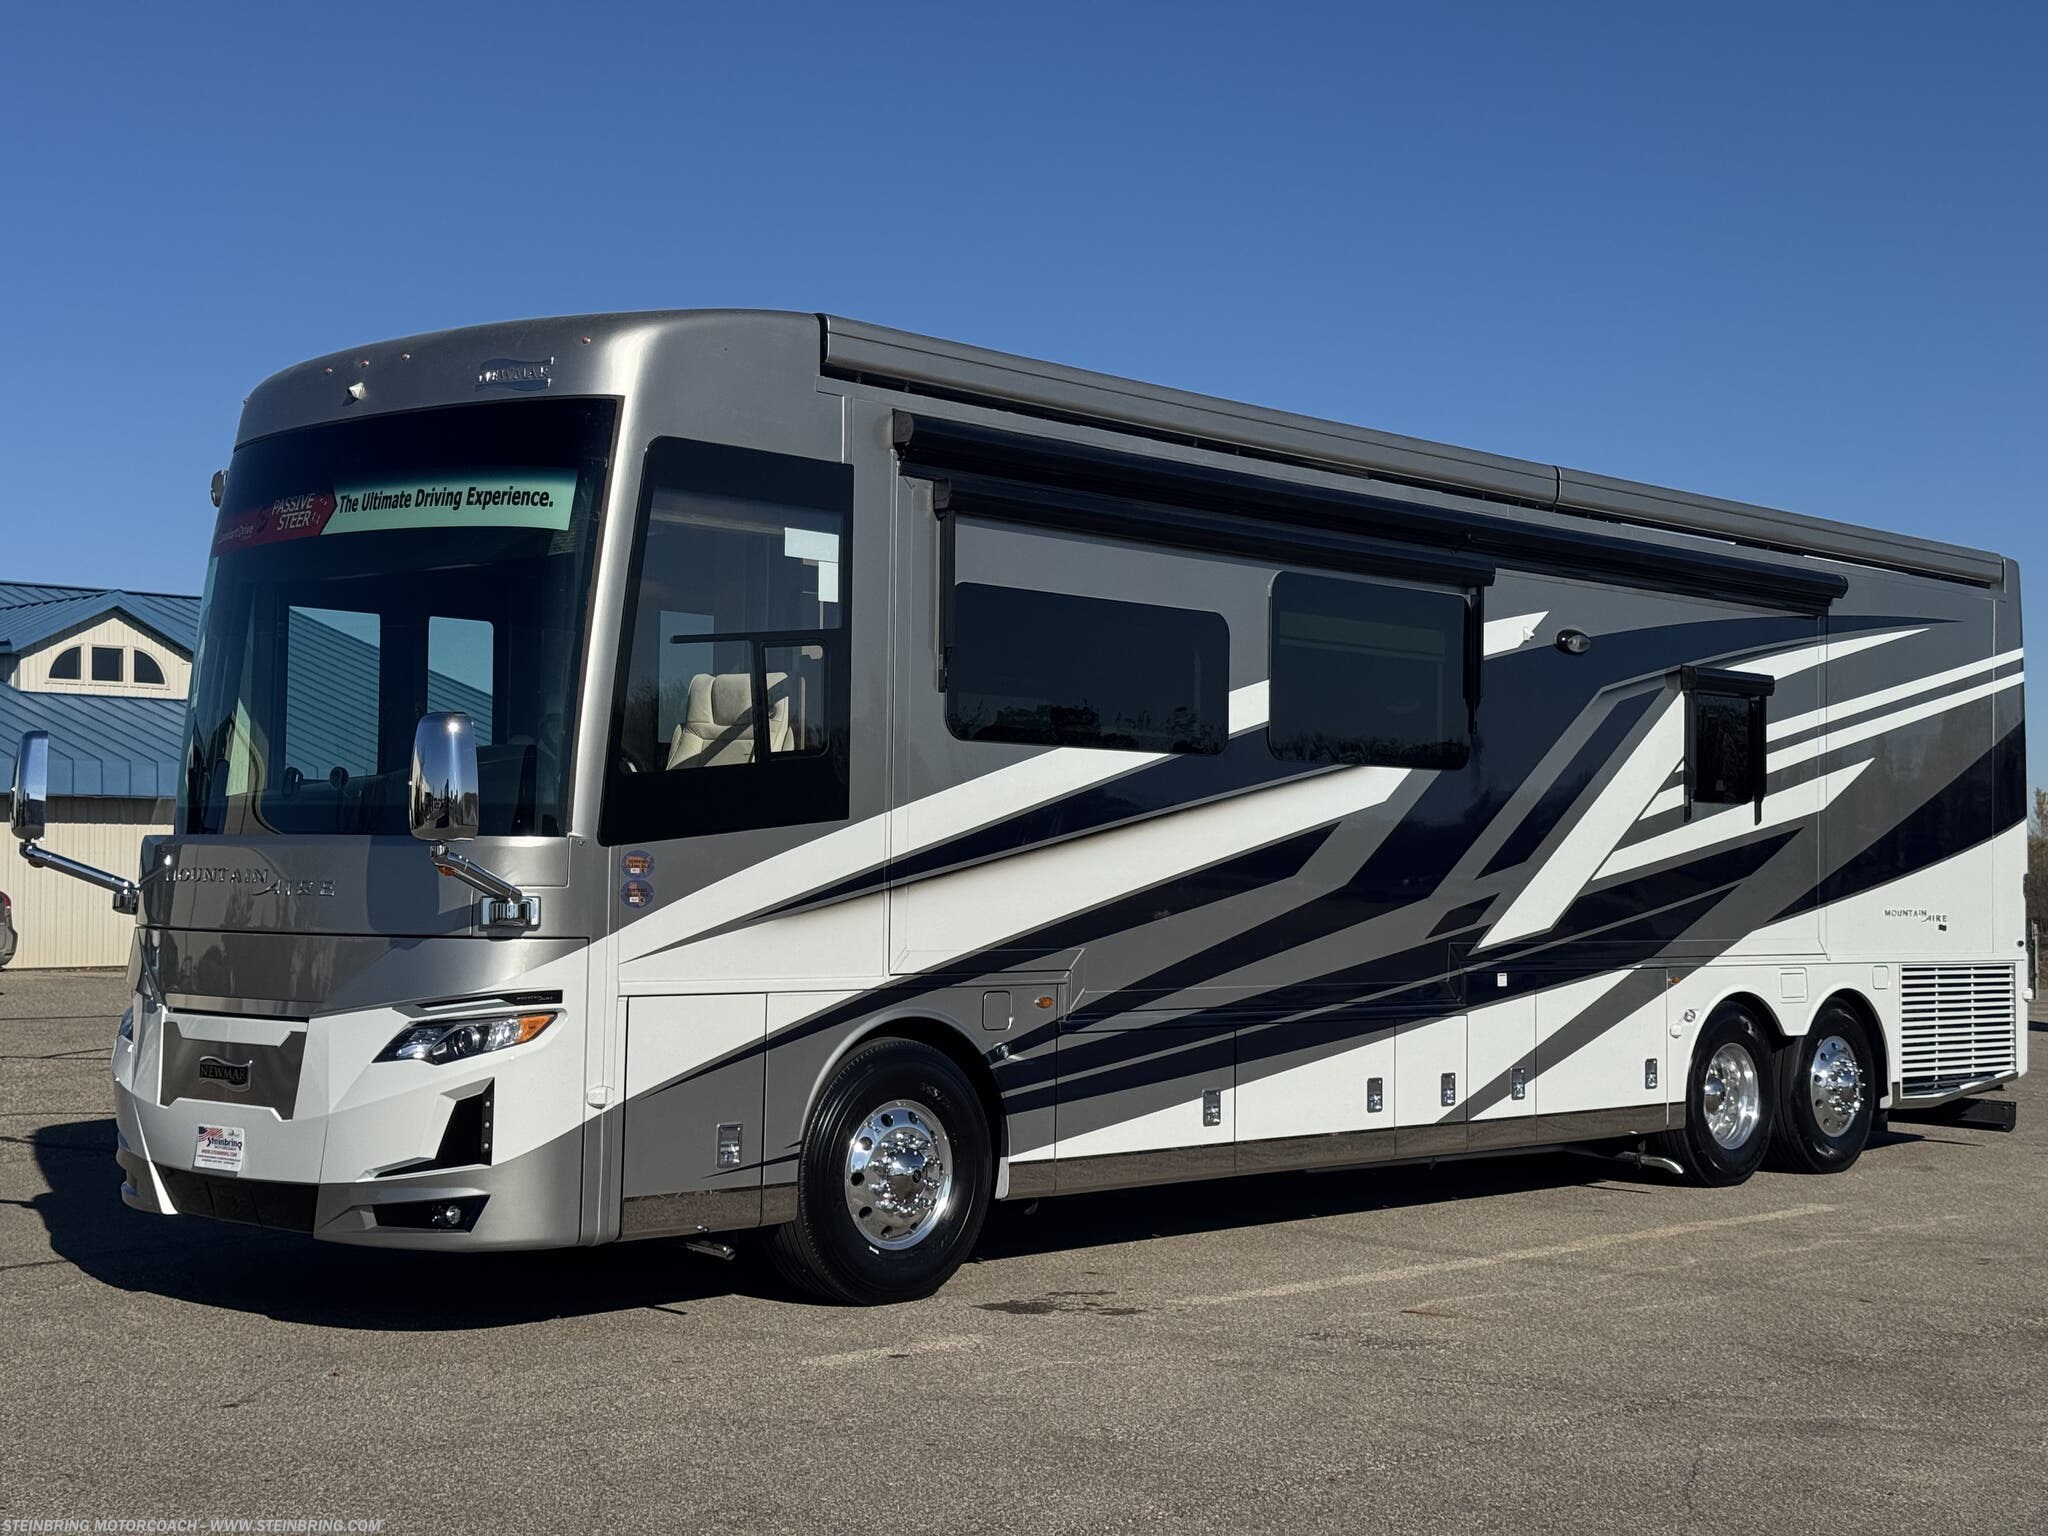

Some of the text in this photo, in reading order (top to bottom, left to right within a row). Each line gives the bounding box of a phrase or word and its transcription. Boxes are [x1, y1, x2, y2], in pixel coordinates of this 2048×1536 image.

[479, 366, 549, 382] NEWMAR
[272, 493, 316, 515] PASSIVE
[339, 486, 554, 513] The Ultimate Driving Experience.
[277, 511, 312, 531] STEER
[165, 867, 268, 884] MOUNTAIN
[1884, 909, 1927, 917] MOUNTAIN
[200, 1064, 247, 1080] NEWMAR
